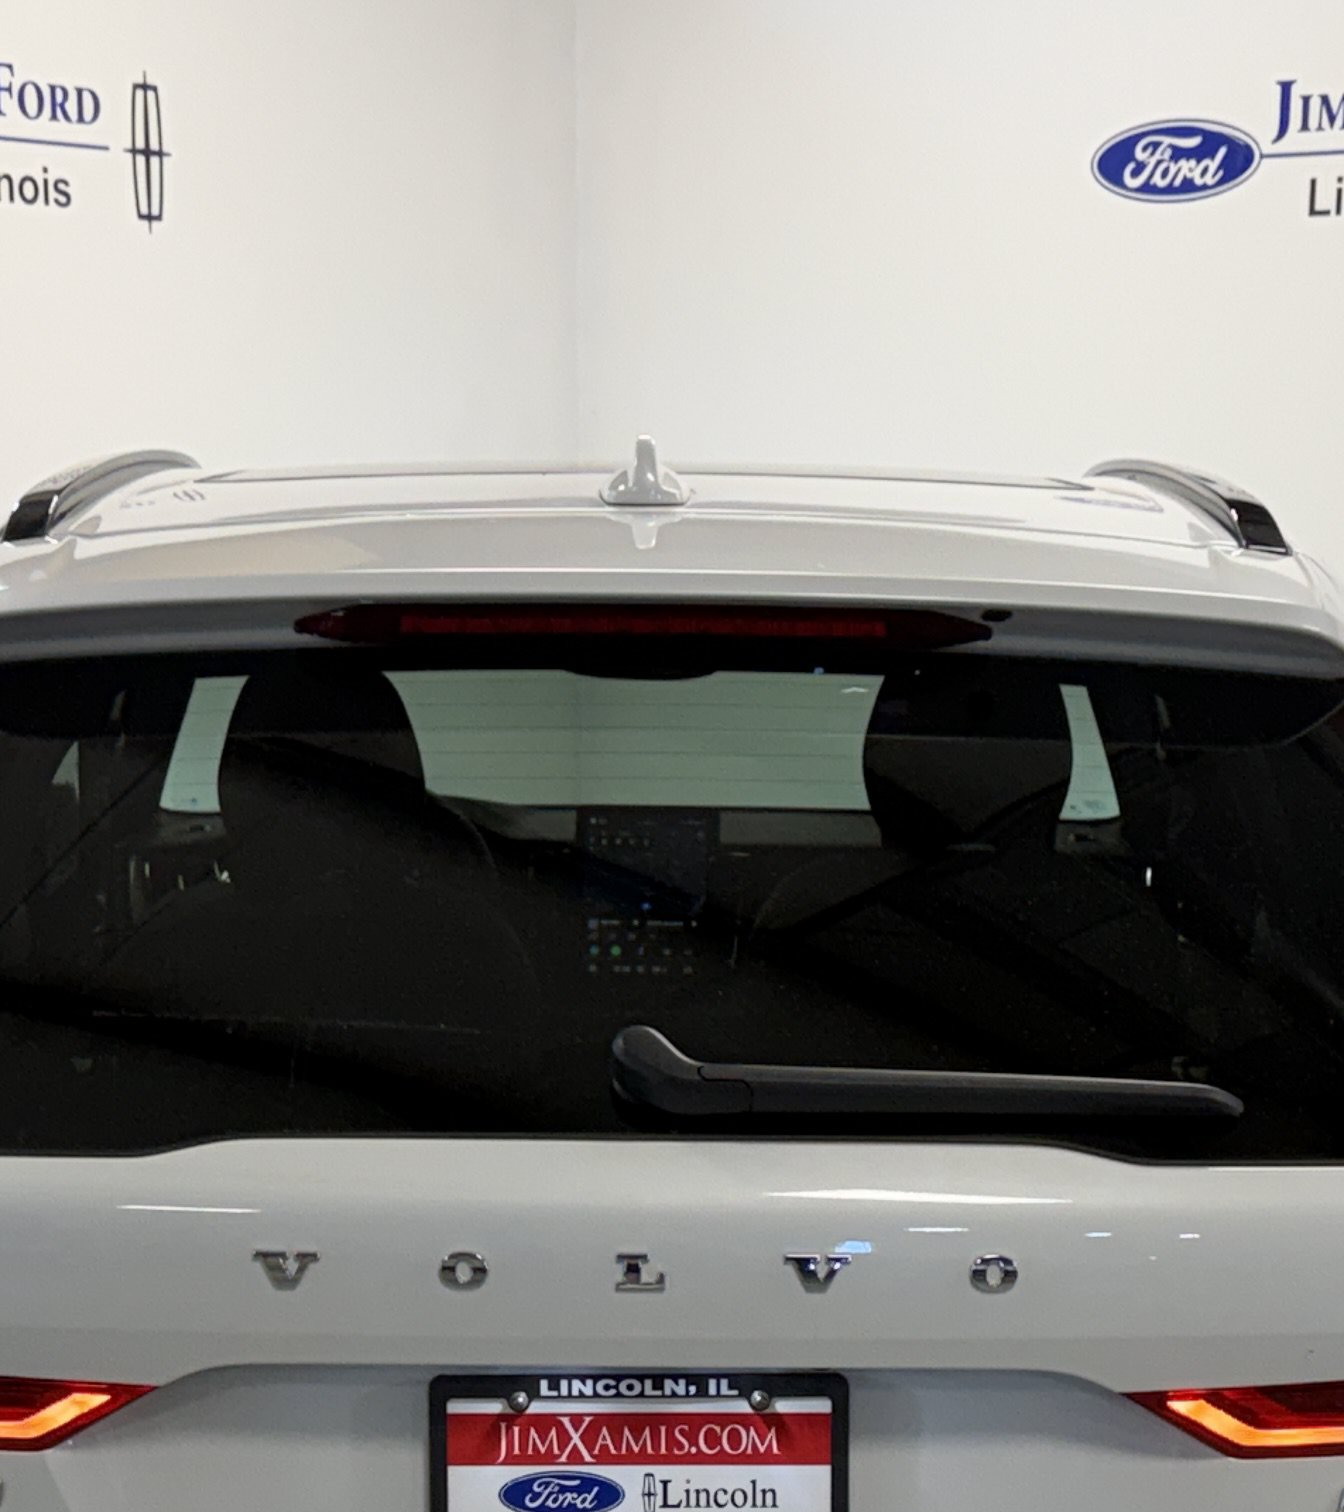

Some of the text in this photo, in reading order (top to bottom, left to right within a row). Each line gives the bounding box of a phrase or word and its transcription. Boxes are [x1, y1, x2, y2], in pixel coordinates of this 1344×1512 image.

[1123, 136, 1225, 190] Ford
[252, 1249, 1019, 1293] VOLVO
[540, 1379, 739, 1398] LINCOLN, IL
[495, 1416, 781, 1463] JIMXAMIS.COM
[524, 1477, 599, 1510] Ford
[659, 1479, 779, 1508] Lincoln
